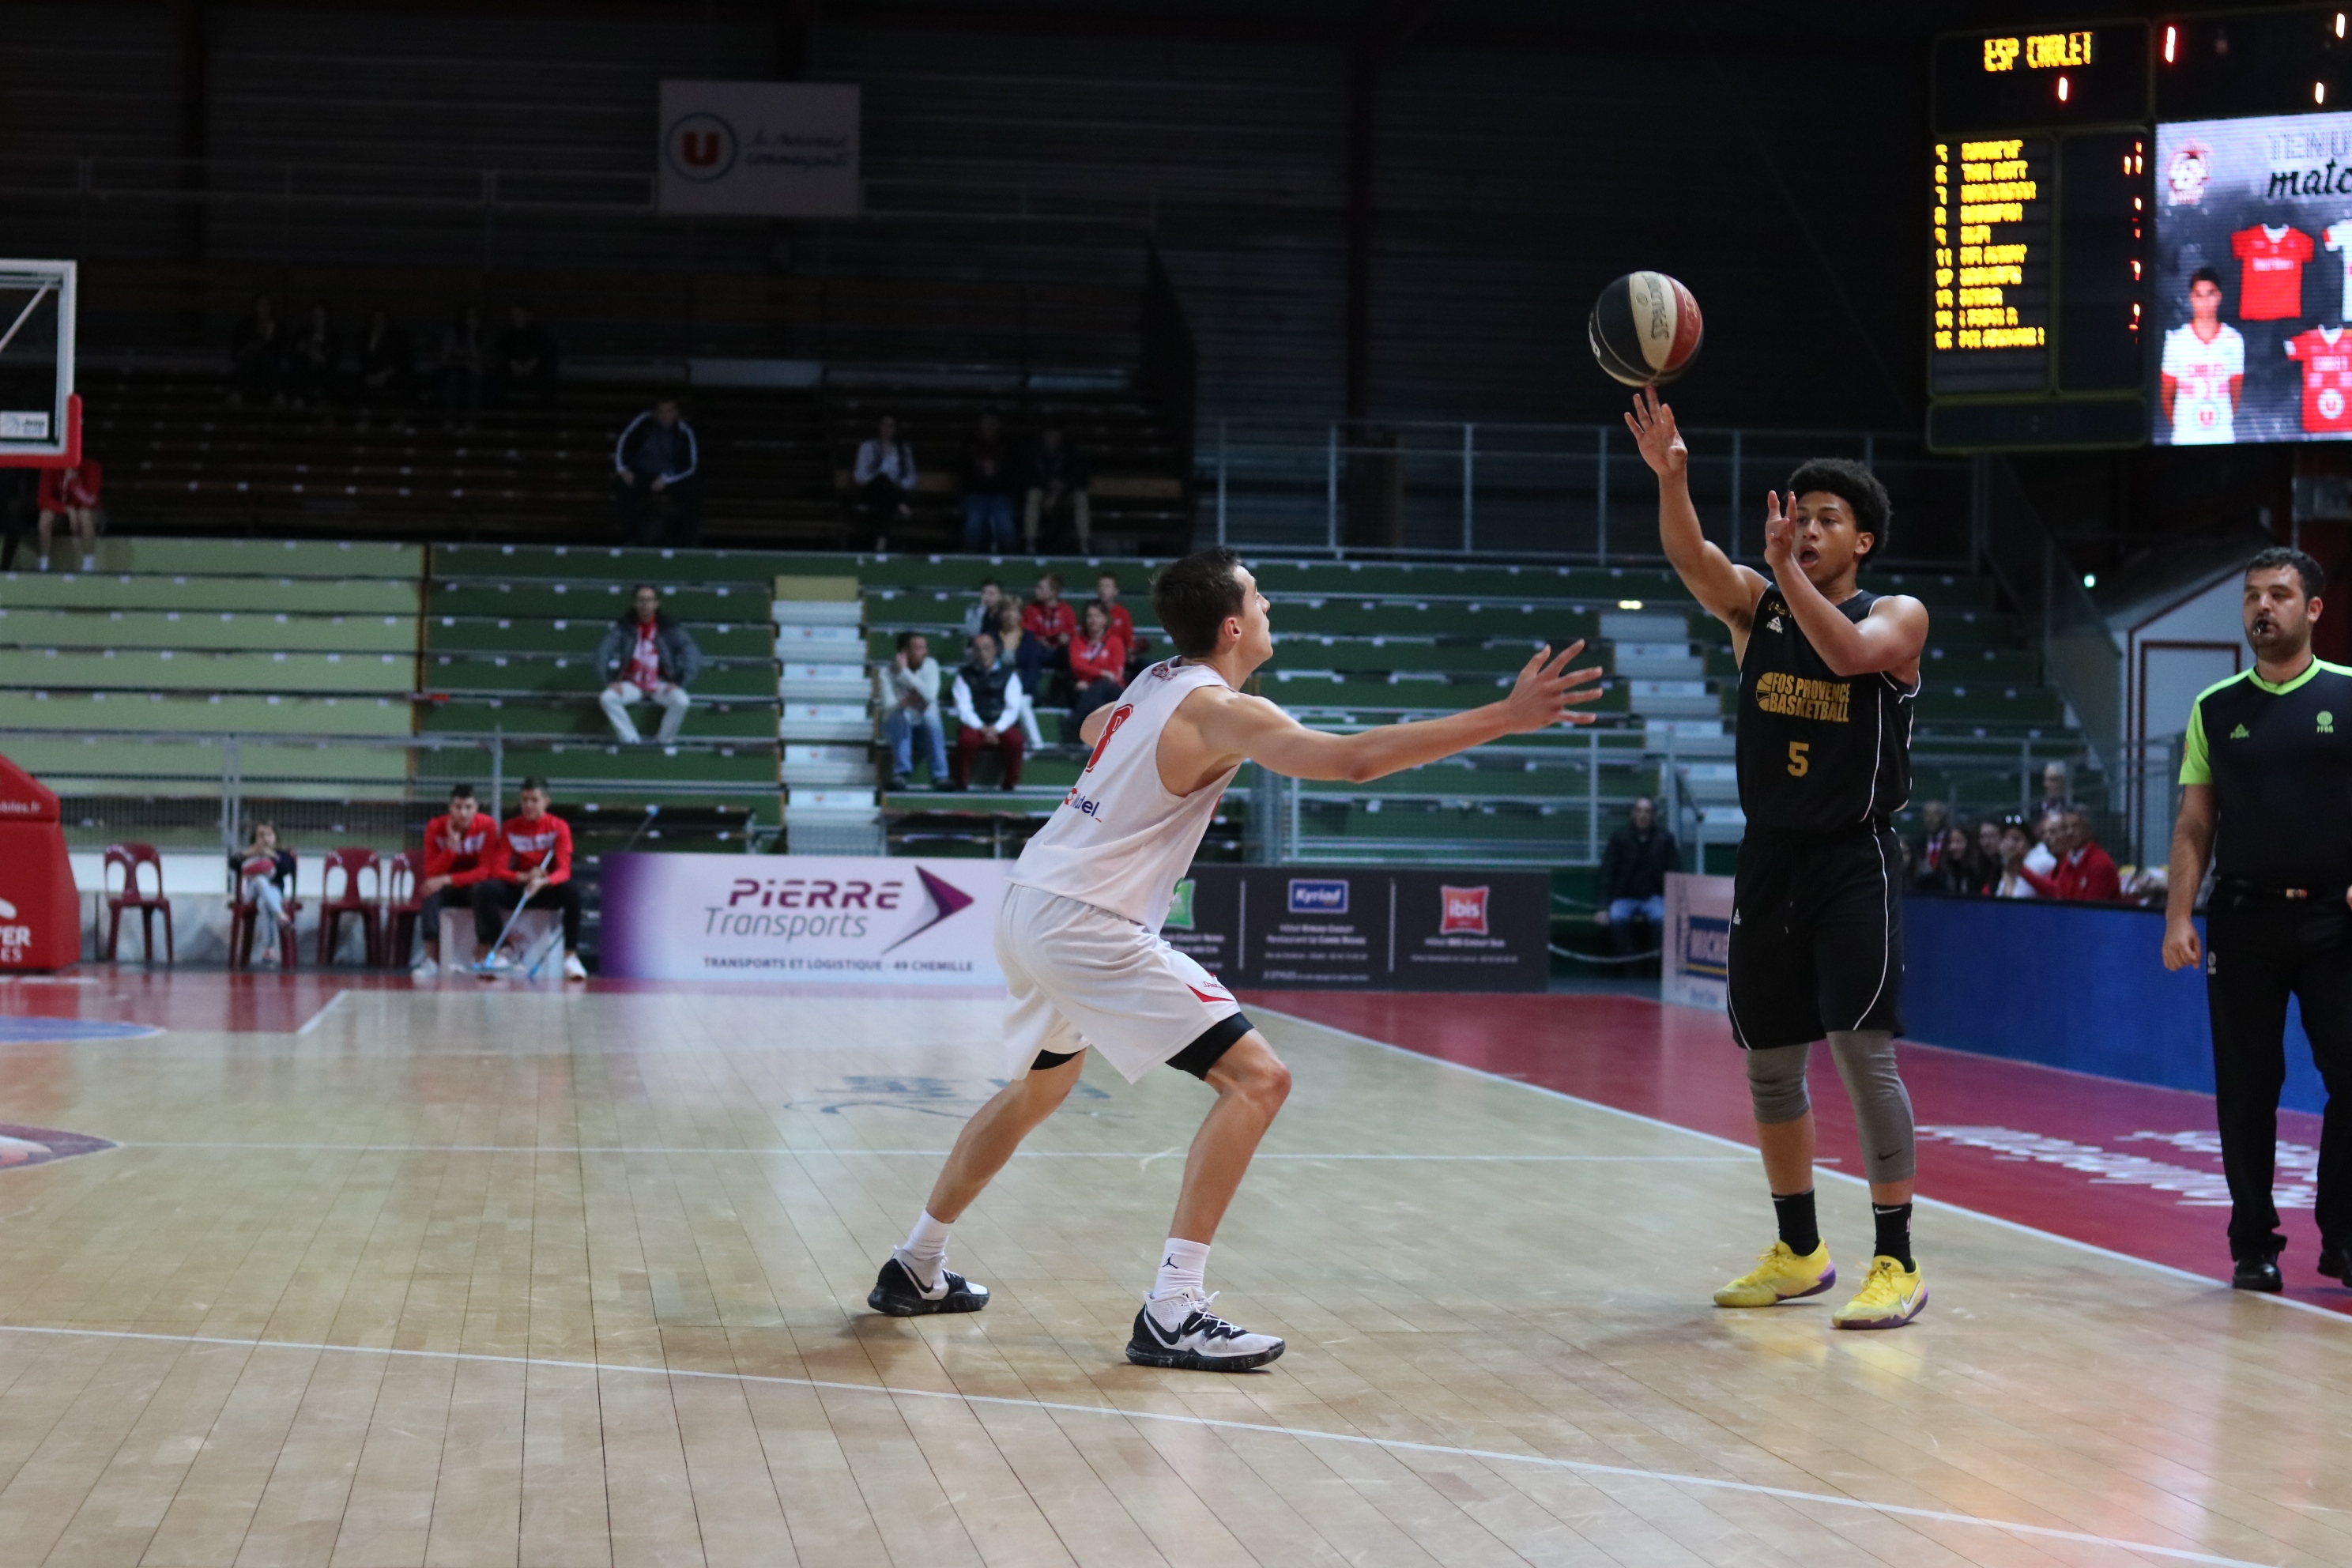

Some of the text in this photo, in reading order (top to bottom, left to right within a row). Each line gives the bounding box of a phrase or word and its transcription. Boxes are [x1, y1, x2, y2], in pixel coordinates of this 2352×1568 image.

[1984, 32, 2094, 71] ESP CHOLET
[1771, 672, 1852, 703] FOS PROVENCE
[1768, 692, 1850, 723] BASKETBALL
[1787, 741, 1811, 778] 5
[1449, 899, 1480, 918] ibis
[0, 925, 31, 947] ER
[704, 908, 869, 943] Transports
[704, 957, 787, 971] TRANSPORTS
[790, 959, 805, 971] ET
[808, 959, 882, 972] LOGISTIQUE
[893, 961, 910, 972] 49
